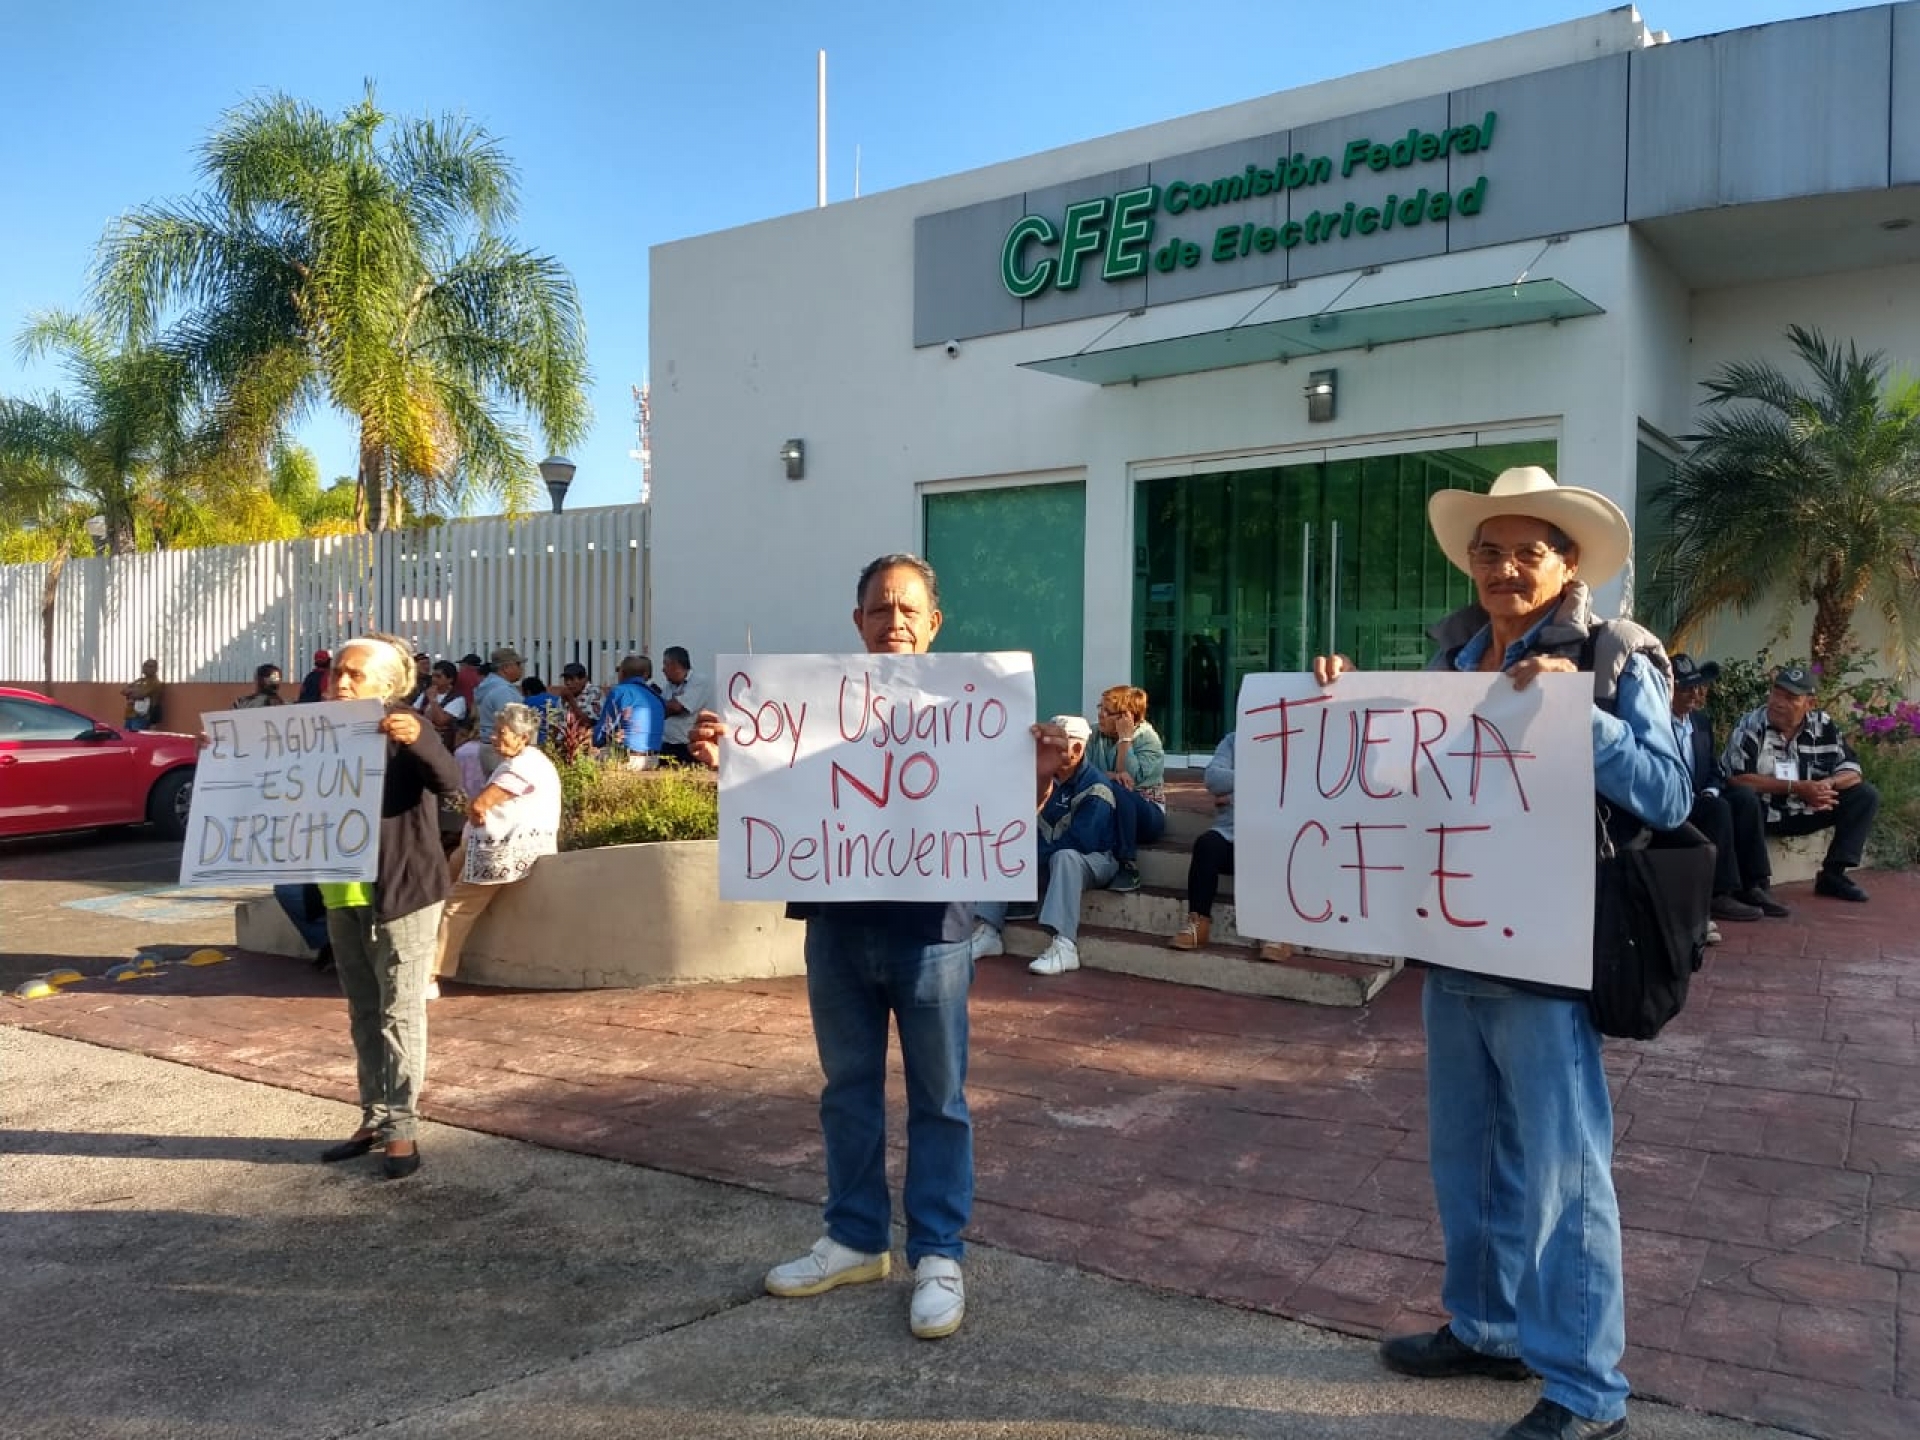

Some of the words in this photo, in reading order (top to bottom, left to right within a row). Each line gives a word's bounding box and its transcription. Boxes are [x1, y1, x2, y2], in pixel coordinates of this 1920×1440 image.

[1162, 154, 1332, 215] Comisión
[1342, 111, 1497, 177] Federal
[1000, 185, 1160, 299] CFE
[1154, 237, 1201, 274] de
[1211, 176, 1488, 262] Electricidad
[210, 719, 249, 759] EL
[261, 715, 346, 759] AGUA
[728, 671, 807, 768] Soy
[839, 671, 1007, 748] Usuario
[1245, 695, 1536, 812] FUERA
[255, 765, 304, 800] ES
[317, 756, 363, 798] UN
[831, 751, 939, 809] NO
[199, 809, 370, 866] DERECHO
[741, 804, 1027, 885] Delincuente
[1287, 819, 1514, 938] C.F.E.
